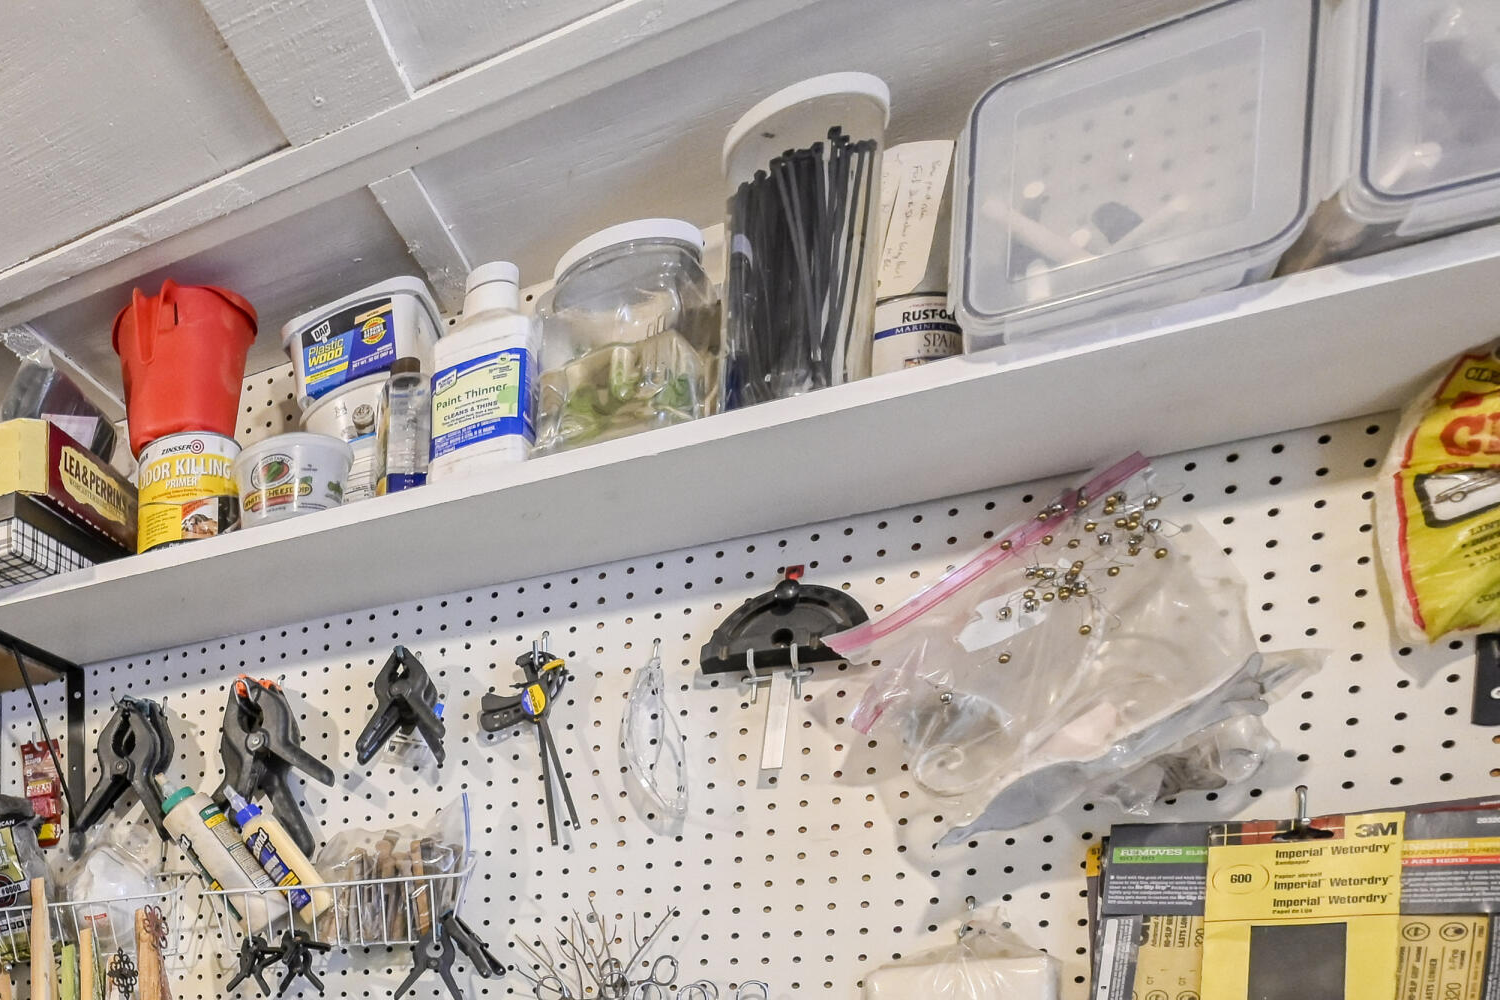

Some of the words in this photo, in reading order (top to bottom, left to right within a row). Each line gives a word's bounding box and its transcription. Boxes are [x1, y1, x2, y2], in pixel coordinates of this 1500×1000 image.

[314, 323, 329, 340] DAP
[309, 338, 344, 356] Plastic
[309, 347, 343, 367] WOOD
[436, 395, 462, 411] Paint
[464, 383, 507, 400] Thinner
[443, 406, 469, 421] CLEANS
[476, 400, 498, 411] THINS
[161, 444, 191, 455] ZINSSER
[176, 458, 232, 479] KILLING
[165, 477, 198, 489] PRIMER
[1355, 821, 1398, 838] 3M
[1120, 848, 1182, 857] REMOVES
[1230, 873, 1252, 884] 600
[1, 884, 22, 897] #0000
